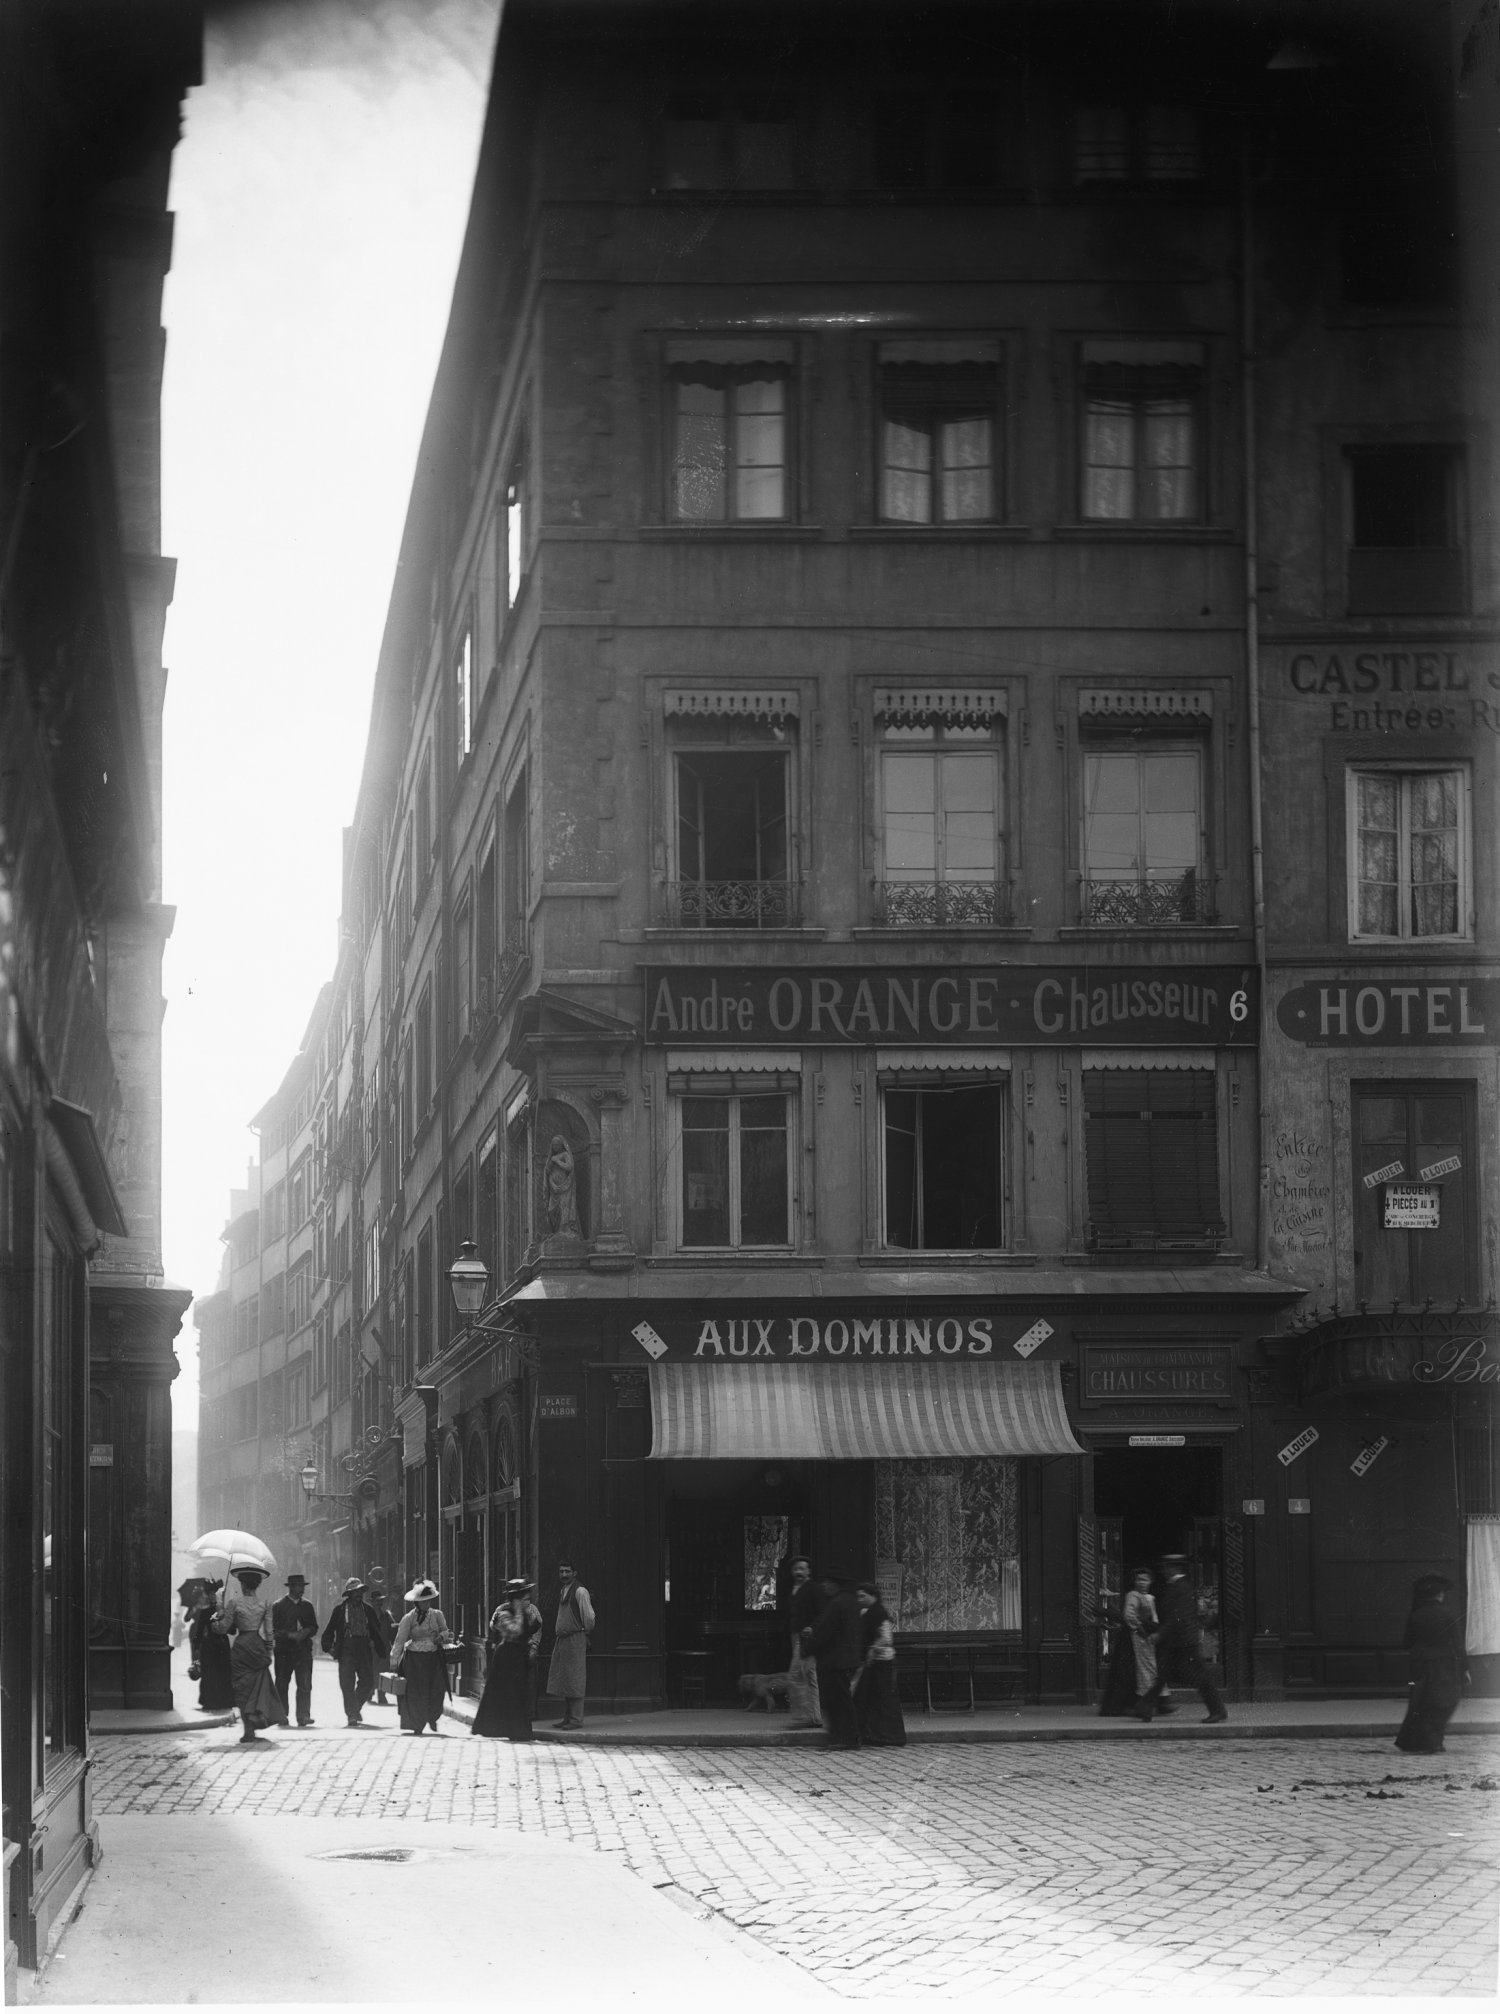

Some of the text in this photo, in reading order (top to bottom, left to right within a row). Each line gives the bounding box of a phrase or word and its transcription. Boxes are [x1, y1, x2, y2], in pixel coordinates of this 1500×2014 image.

[1289, 651, 1471, 695] CASTEL
[767, 976, 1000, 1042] ORANGE
[1032, 976, 1219, 1034] Chausseur
[1229, 990, 1248, 1022] 6
[1318, 985, 1487, 1036] HOTEL
[1374, 1162, 1404, 1183] LOUER
[1430, 1157, 1460, 1178] LOUER
[1400, 1185, 1431, 1195] LOUER
[693, 1317, 994, 1357] AUX DOMINOS
[1412, 1336, 1500, 1384] Bo
[1090, 1370, 1226, 1391] CHAUSSURES
[541, 1407, 576, 1416] D'ALBON
[546, 1398, 572, 1406] PLACE
[1288, 1429, 1316, 1456] LOUER
[1359, 1437, 1386, 1465] LOUER
[1249, 1501, 1258, 1513] 6
[1294, 1501, 1303, 1513] 4
[1224, 1516, 1246, 1622] CHAUSSURES
